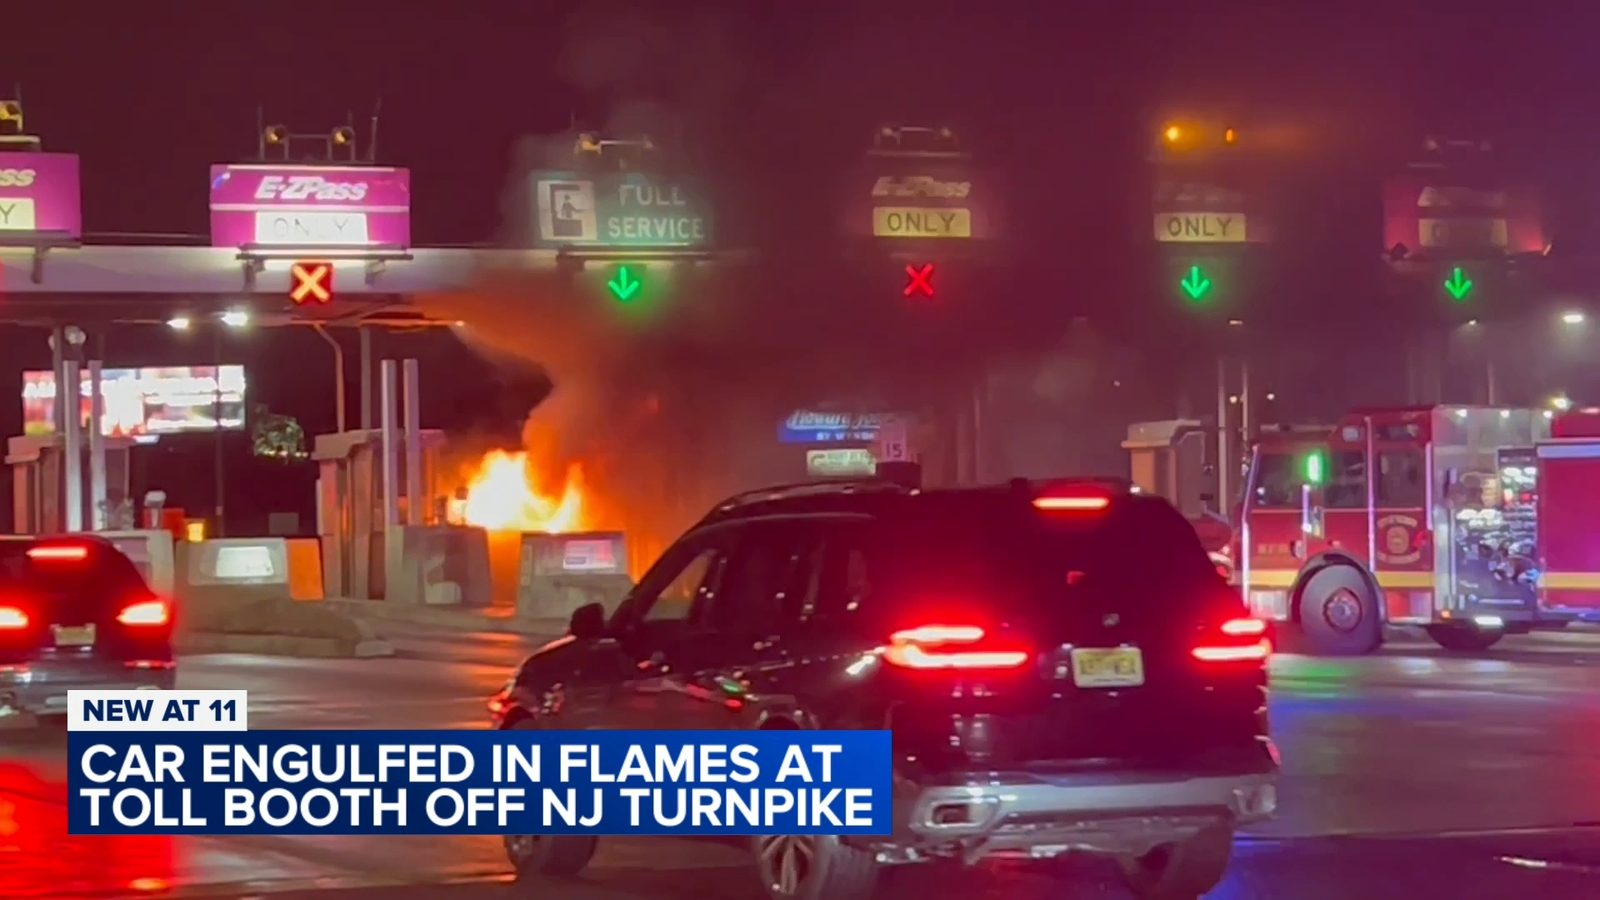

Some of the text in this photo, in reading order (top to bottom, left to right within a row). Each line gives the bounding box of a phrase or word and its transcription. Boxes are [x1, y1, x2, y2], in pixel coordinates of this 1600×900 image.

[254, 175, 368, 200] E-ZPass
[618, 184, 686, 207] FULL
[608, 216, 705, 239] SERVICE
[887, 211, 956, 233] ONLY
[1167, 216, 1232, 237] ONLY
[886, 442, 903, 459] 15
